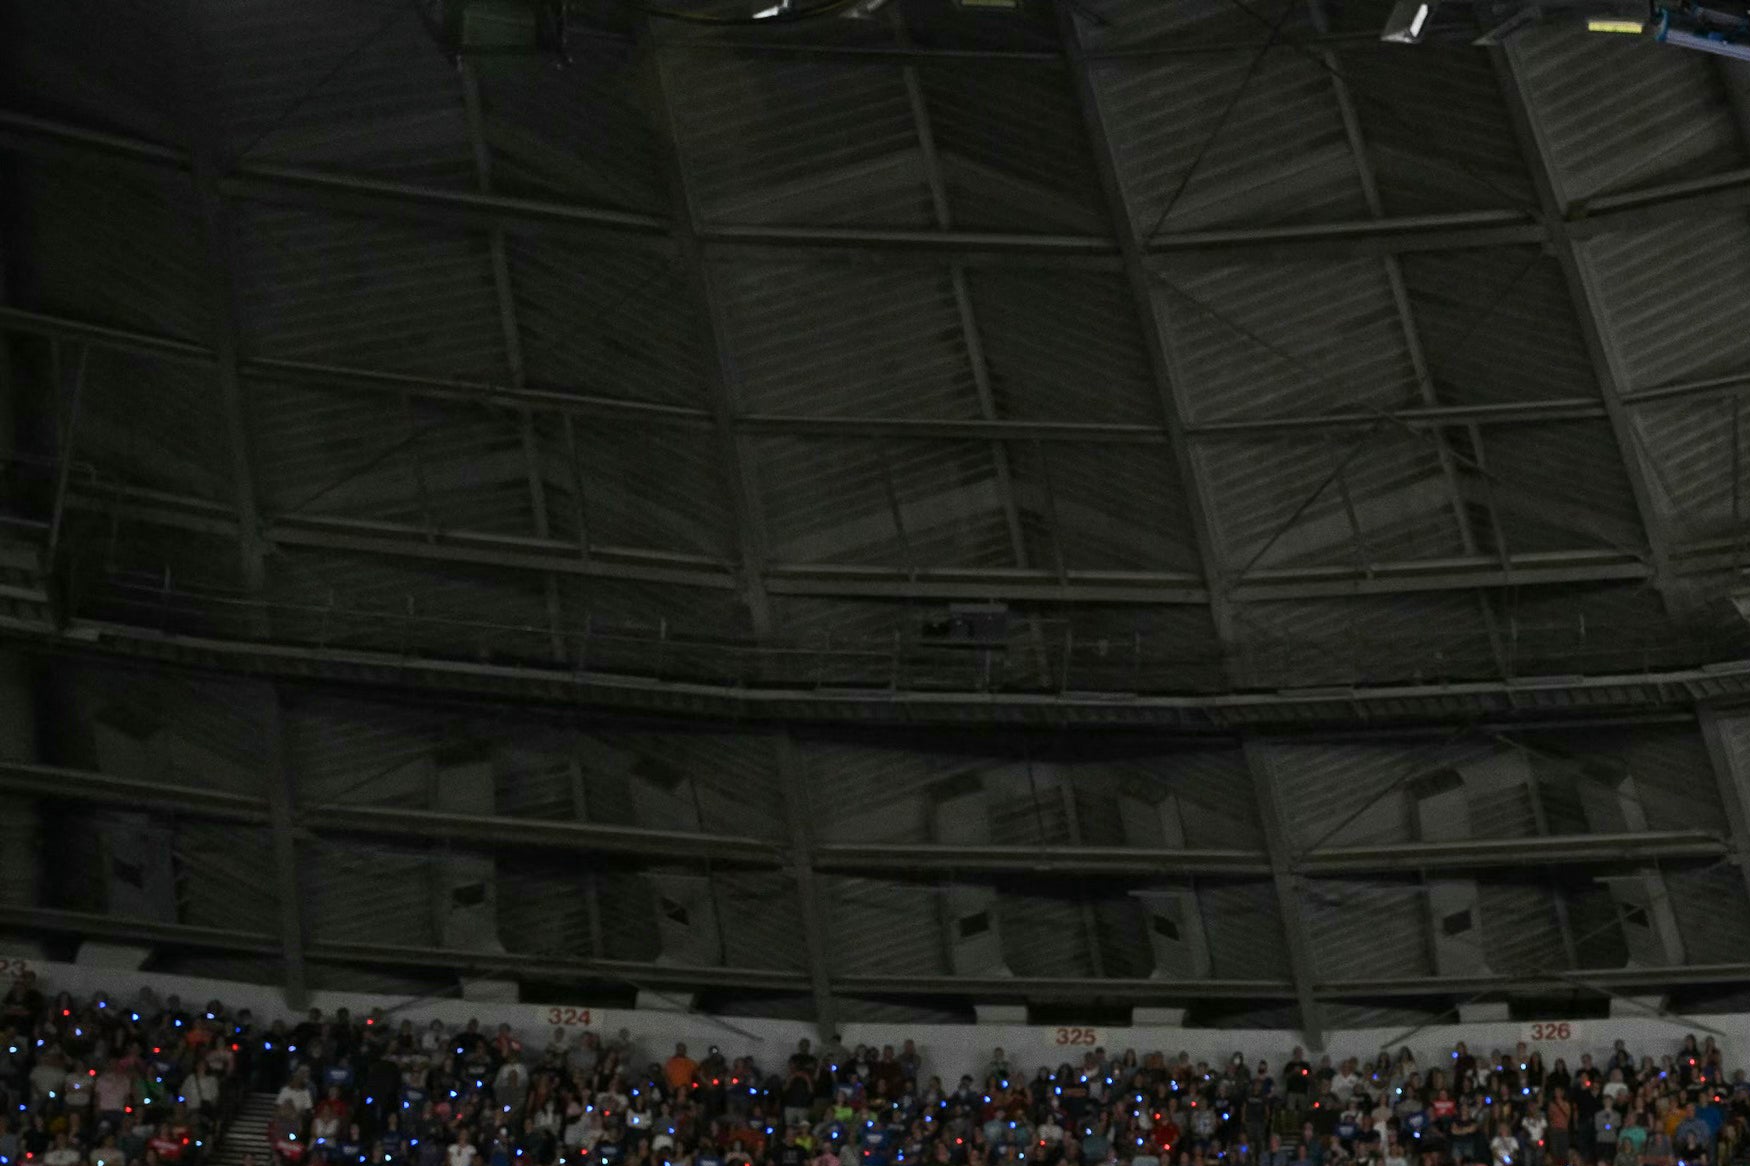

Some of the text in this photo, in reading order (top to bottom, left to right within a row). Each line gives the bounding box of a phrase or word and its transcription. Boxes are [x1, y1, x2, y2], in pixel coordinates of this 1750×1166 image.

[548, 1008, 590, 1027] 324
[1055, 1025, 1096, 1046] 325
[1530, 1022, 1571, 1042] 326
